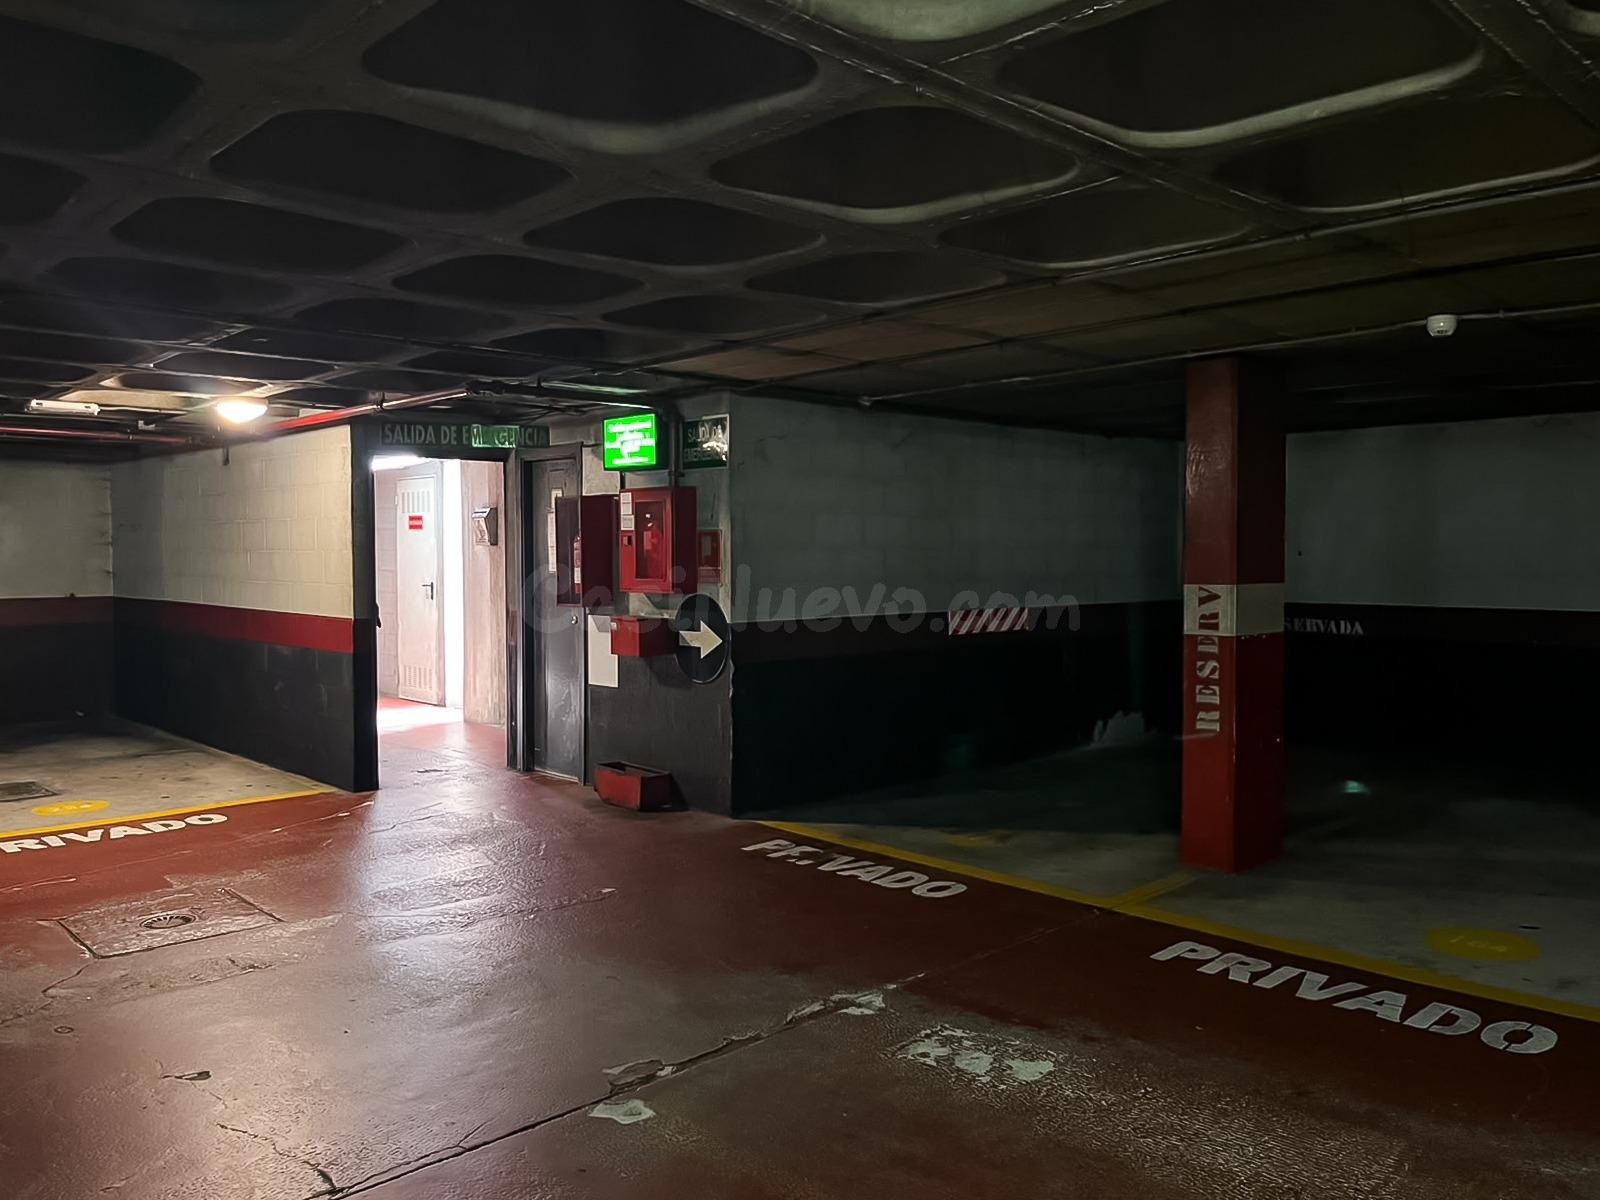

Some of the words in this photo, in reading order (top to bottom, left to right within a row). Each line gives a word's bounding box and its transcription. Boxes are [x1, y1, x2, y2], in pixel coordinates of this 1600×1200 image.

[384, 424, 436, 445] SALIDA
[440, 425, 457, 445] DE
[740, 839, 967, 898] PRVADO
[1150, 940, 1558, 1054] PRIVADO
